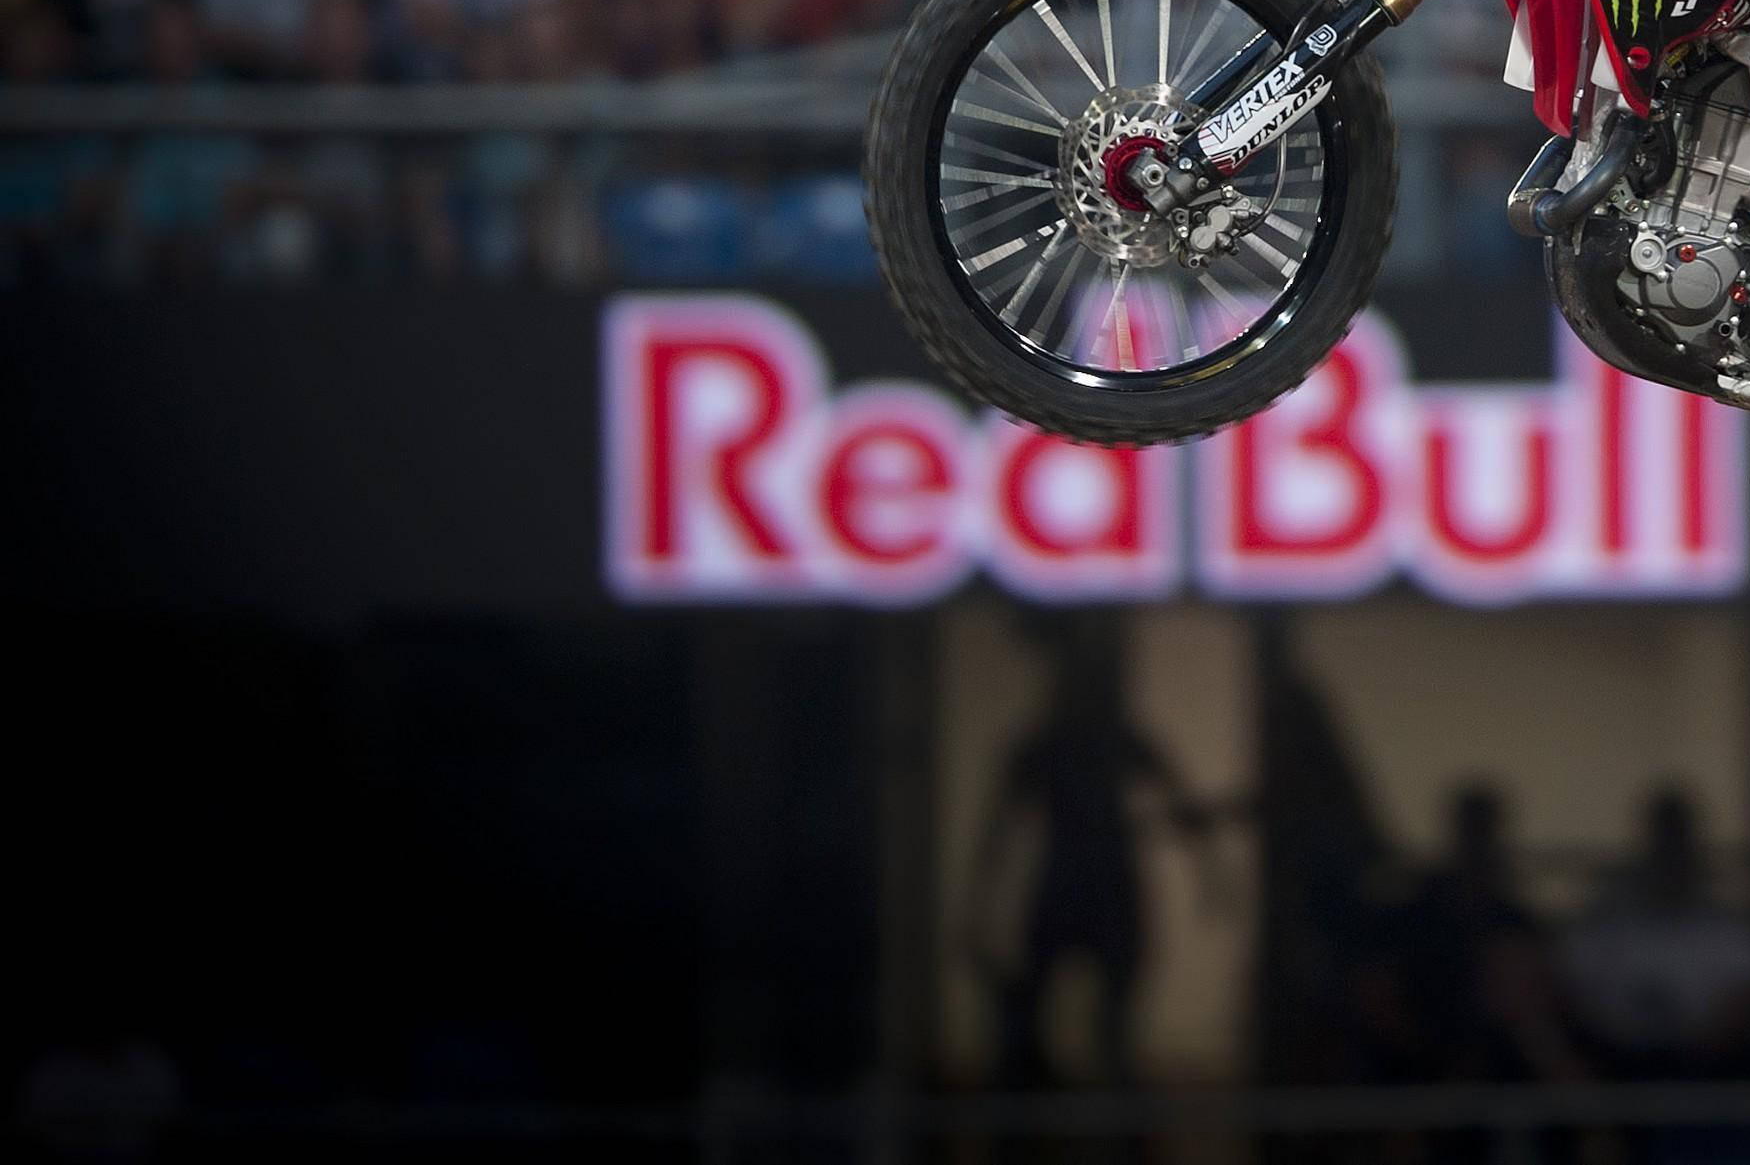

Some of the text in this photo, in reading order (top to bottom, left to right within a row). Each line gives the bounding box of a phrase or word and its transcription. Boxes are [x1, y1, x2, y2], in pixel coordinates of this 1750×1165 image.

[1209, 51, 1304, 144] VERTEX
[1232, 75, 1324, 167] DUNLOP
[635, 316, 1708, 568] Red Bull
